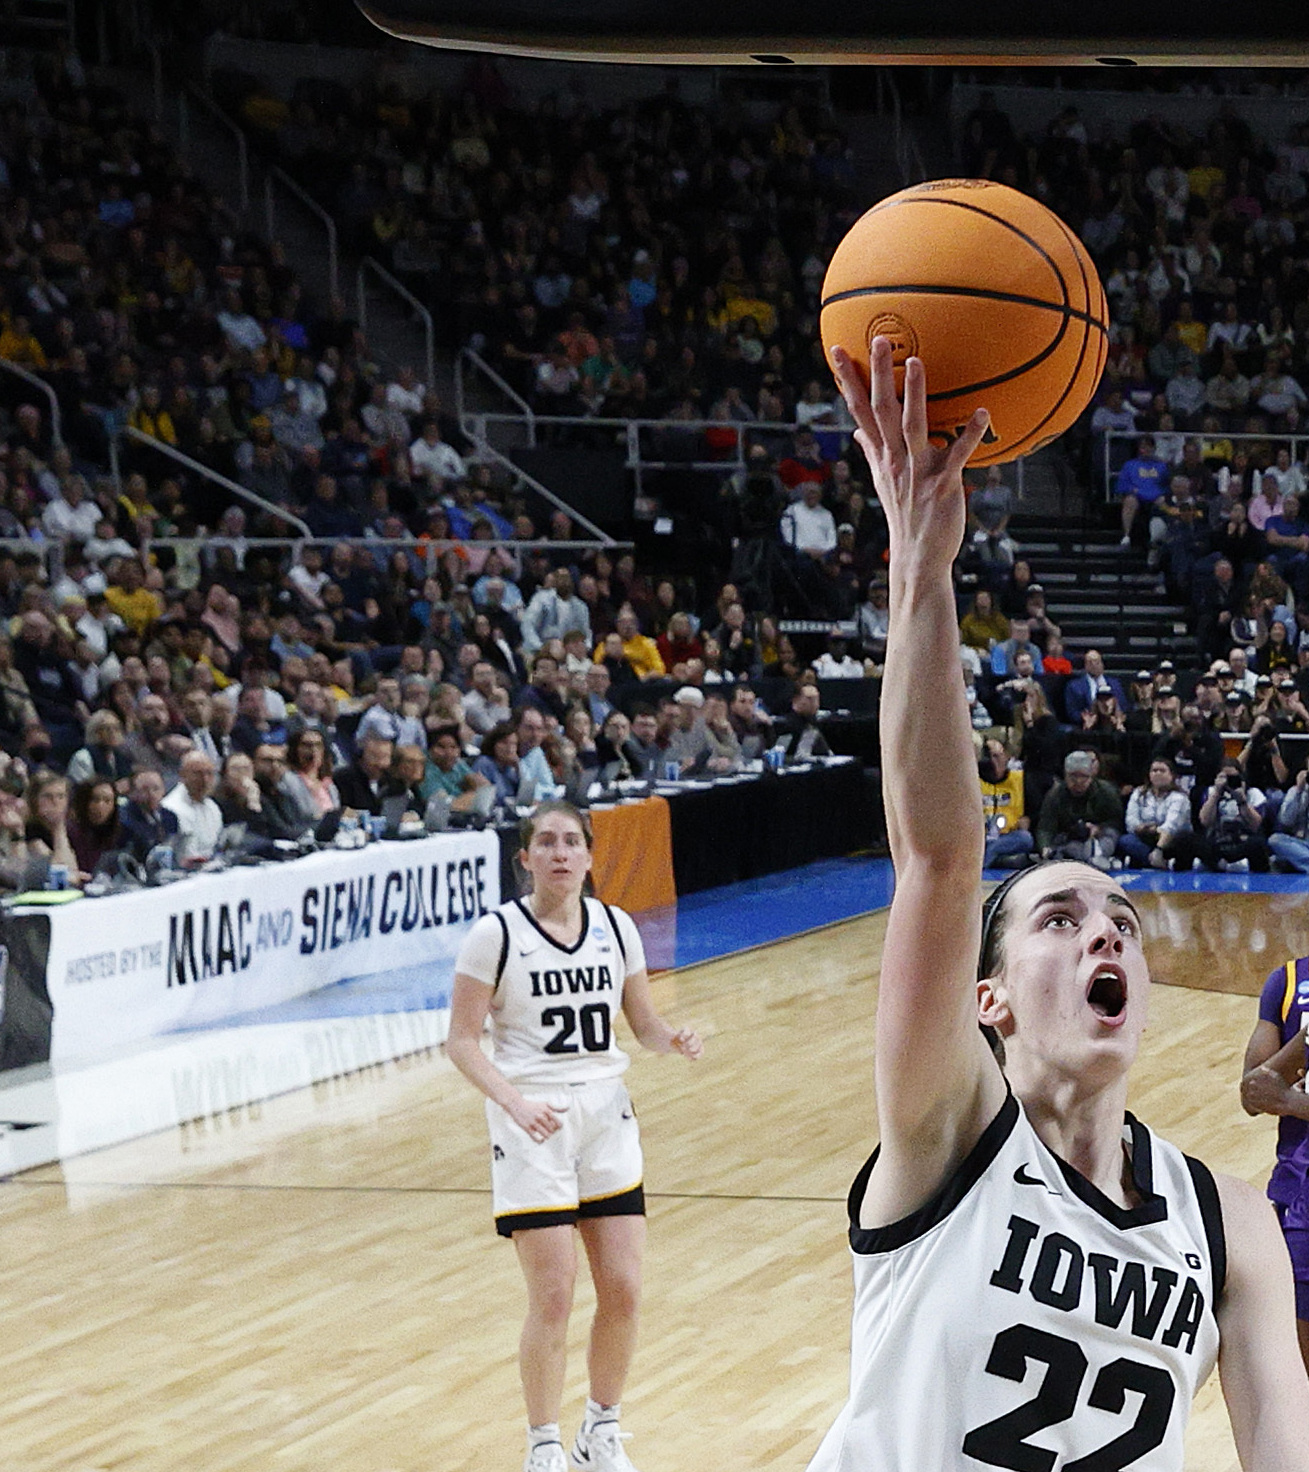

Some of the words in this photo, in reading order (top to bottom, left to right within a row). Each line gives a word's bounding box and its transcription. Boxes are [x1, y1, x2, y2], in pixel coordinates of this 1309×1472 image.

[120, 947, 138, 974] BY
[255, 909, 294, 953] AND
[301, 873, 376, 955] SIENA
[378, 855, 489, 935] COLLEGE
[529, 965, 613, 997] IOWA
[541, 1002, 610, 1054] 20
[989, 1214, 1205, 1355] IOWA
